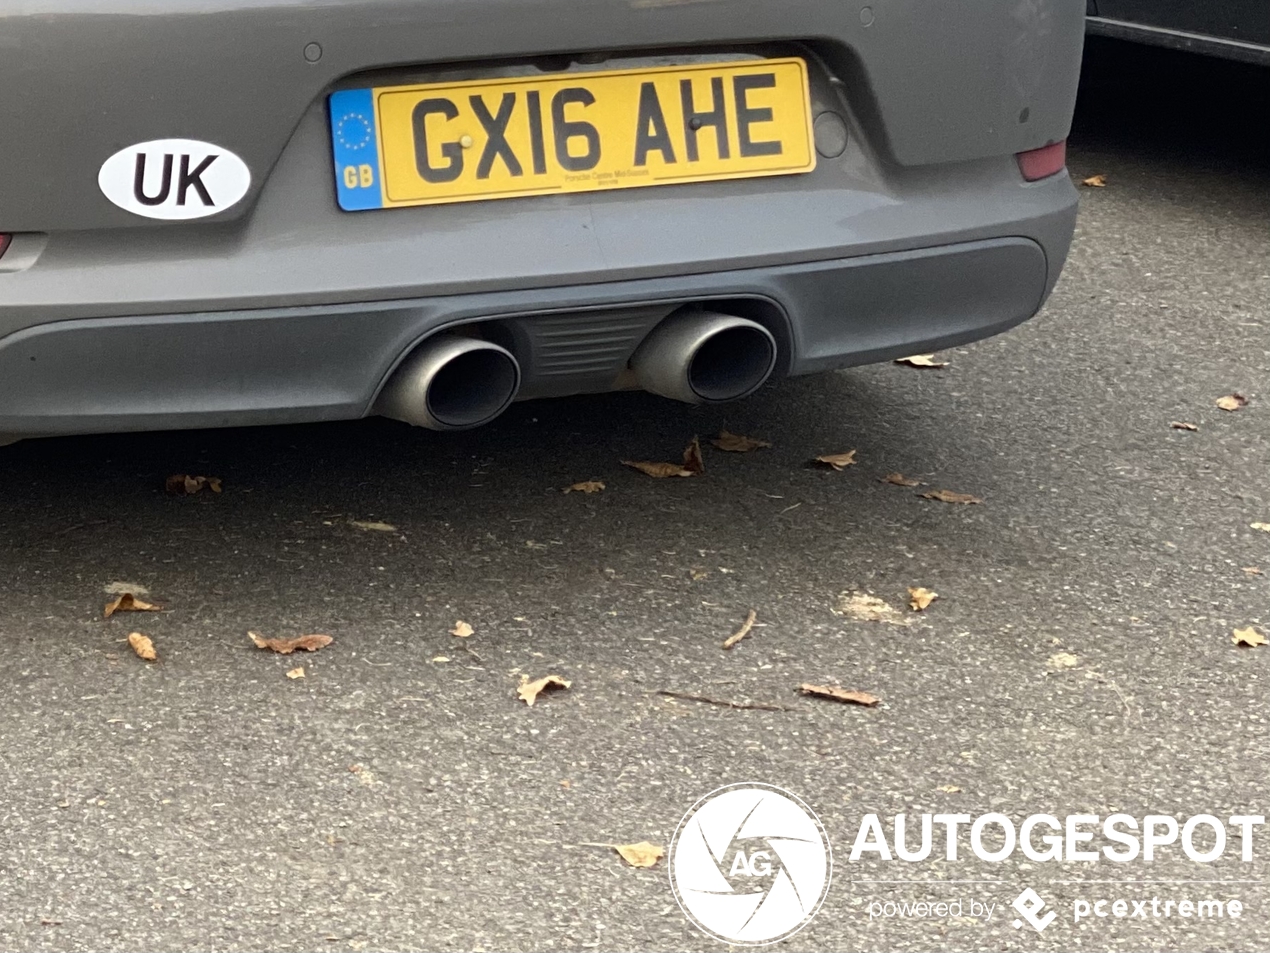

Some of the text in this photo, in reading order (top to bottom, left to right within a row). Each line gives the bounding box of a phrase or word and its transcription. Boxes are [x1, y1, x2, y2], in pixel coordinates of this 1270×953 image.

[411, 73, 783, 184] GX16 AHE
[133, 152, 220, 207] UK
[343, 164, 374, 189] GB
